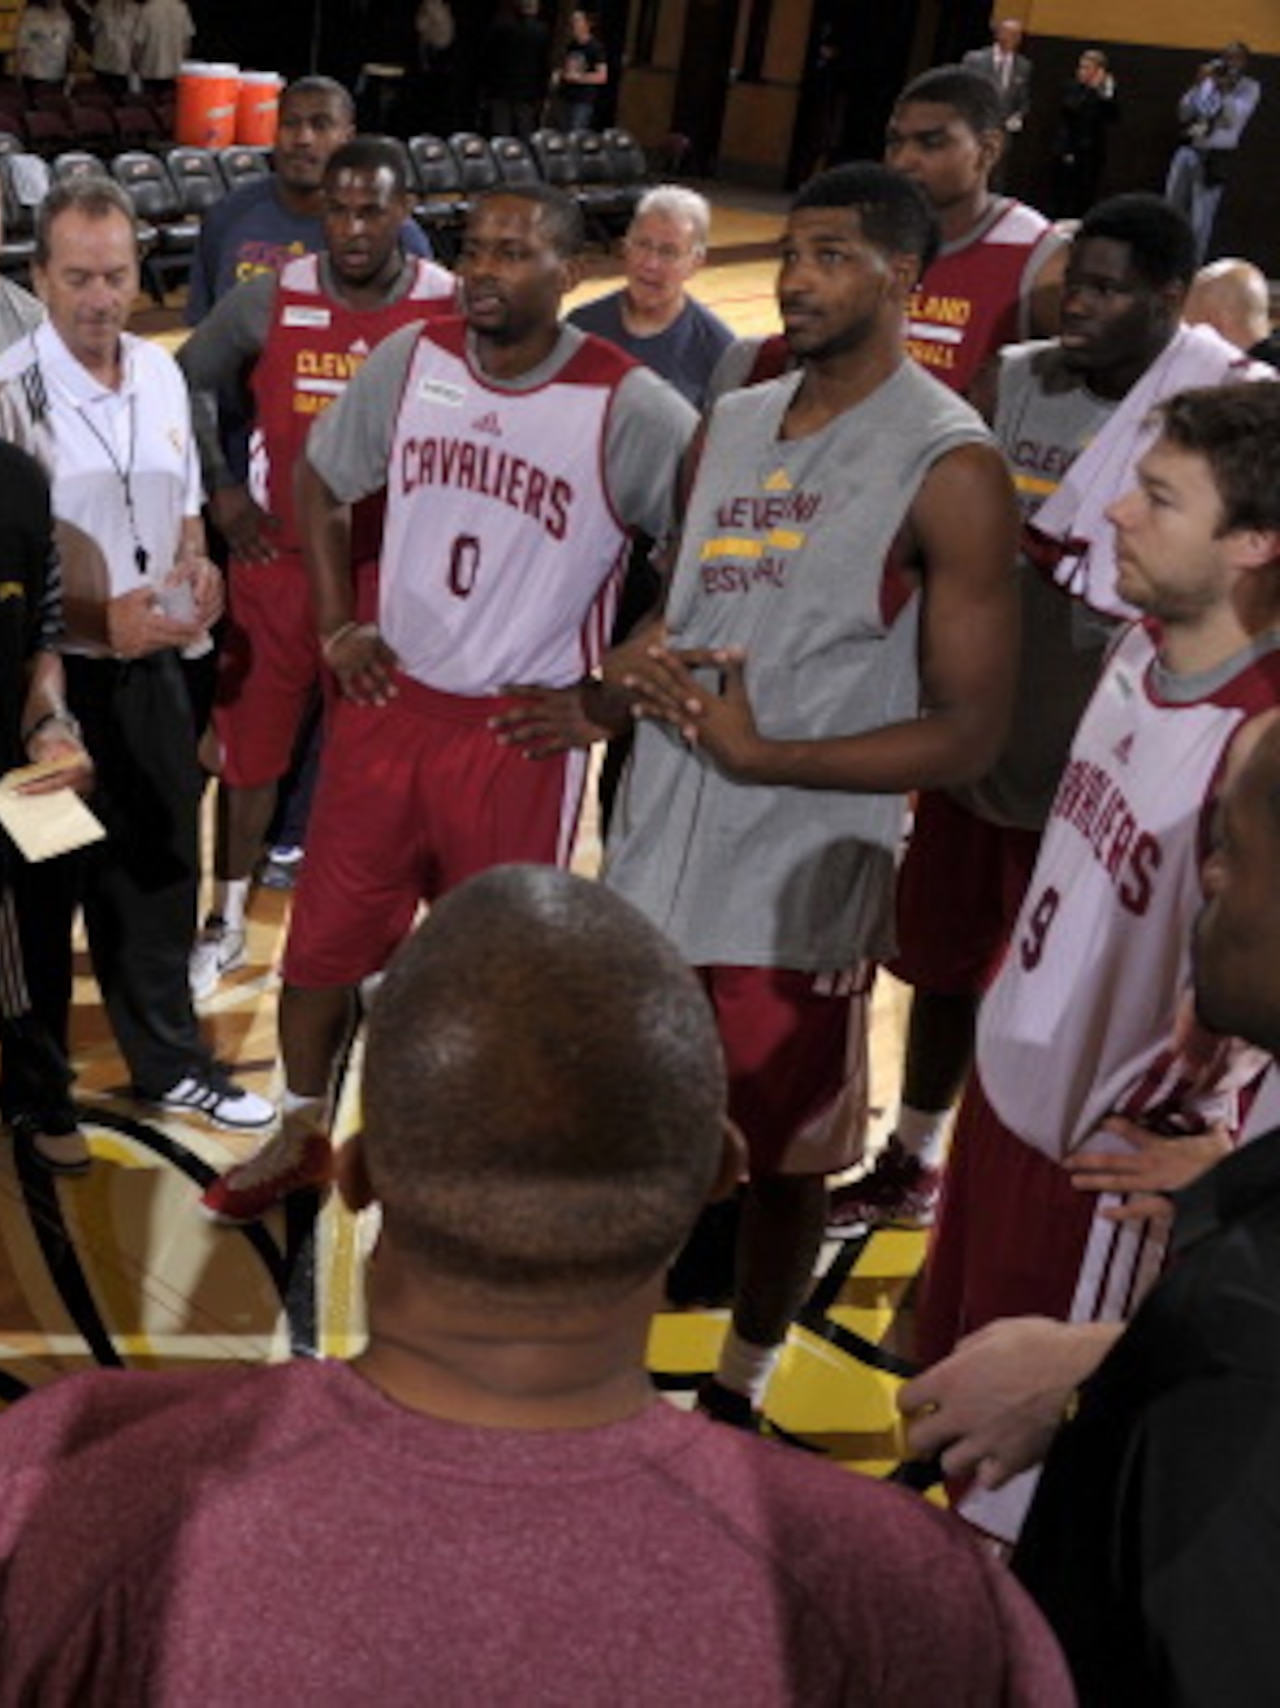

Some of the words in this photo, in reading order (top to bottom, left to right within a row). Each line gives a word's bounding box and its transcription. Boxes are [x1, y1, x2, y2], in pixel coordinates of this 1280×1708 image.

[402, 436, 574, 542] CAVALIERS
[447, 533, 480, 600] 0
[1021, 886, 1059, 972] 9
